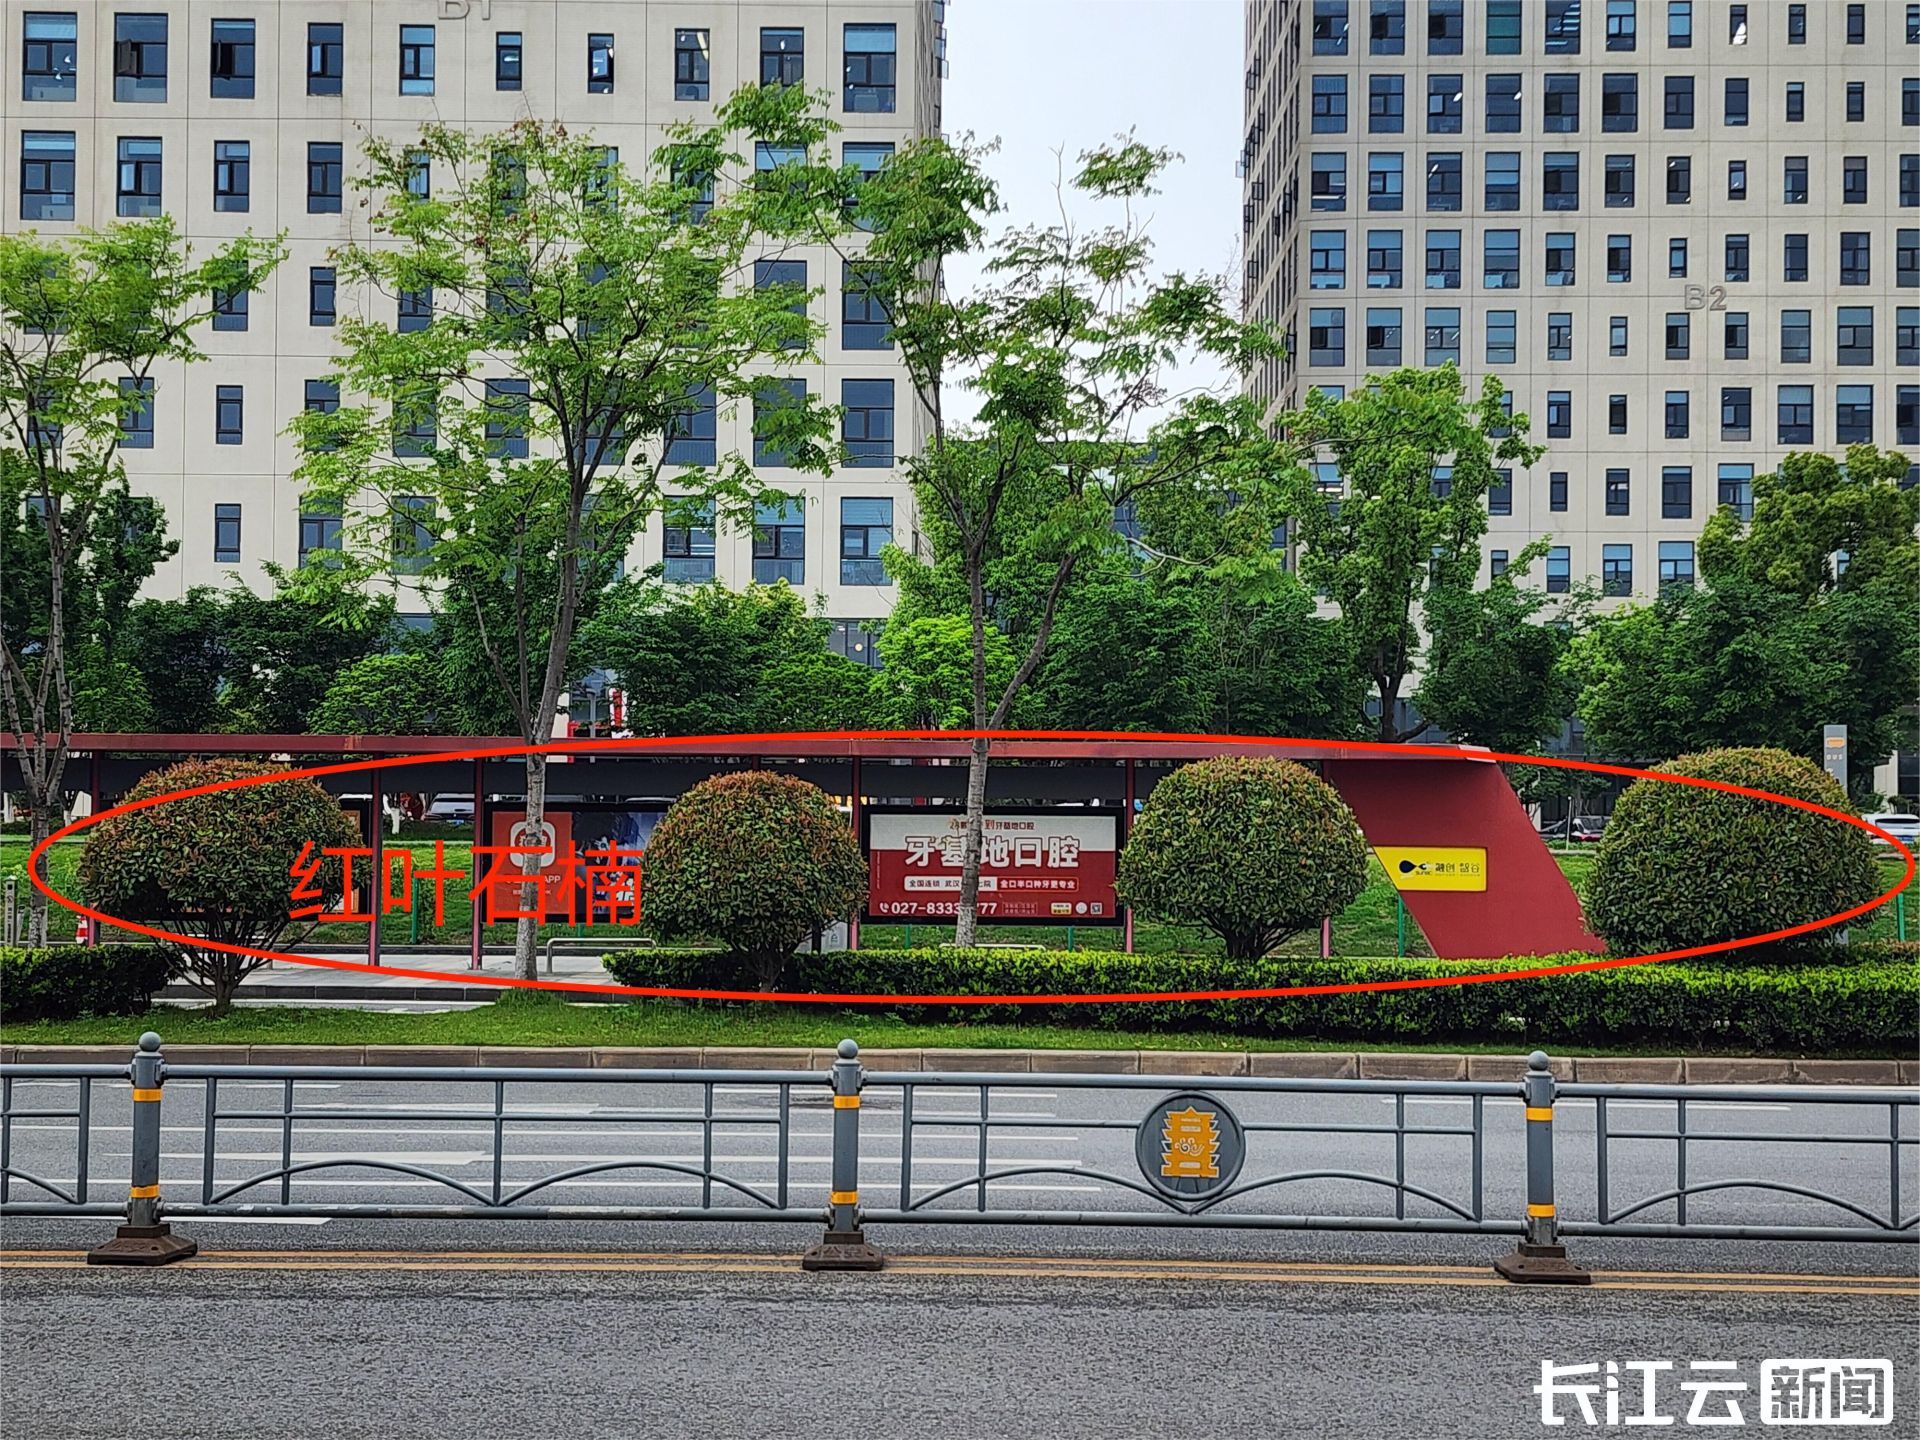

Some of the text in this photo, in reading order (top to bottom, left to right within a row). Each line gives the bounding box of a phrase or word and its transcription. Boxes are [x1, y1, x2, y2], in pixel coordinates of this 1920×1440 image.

[1684, 284, 1727, 311] B2
[904, 835, 1081, 868] 牙基地口腔
[891, 902, 998, 915] 027-833377
